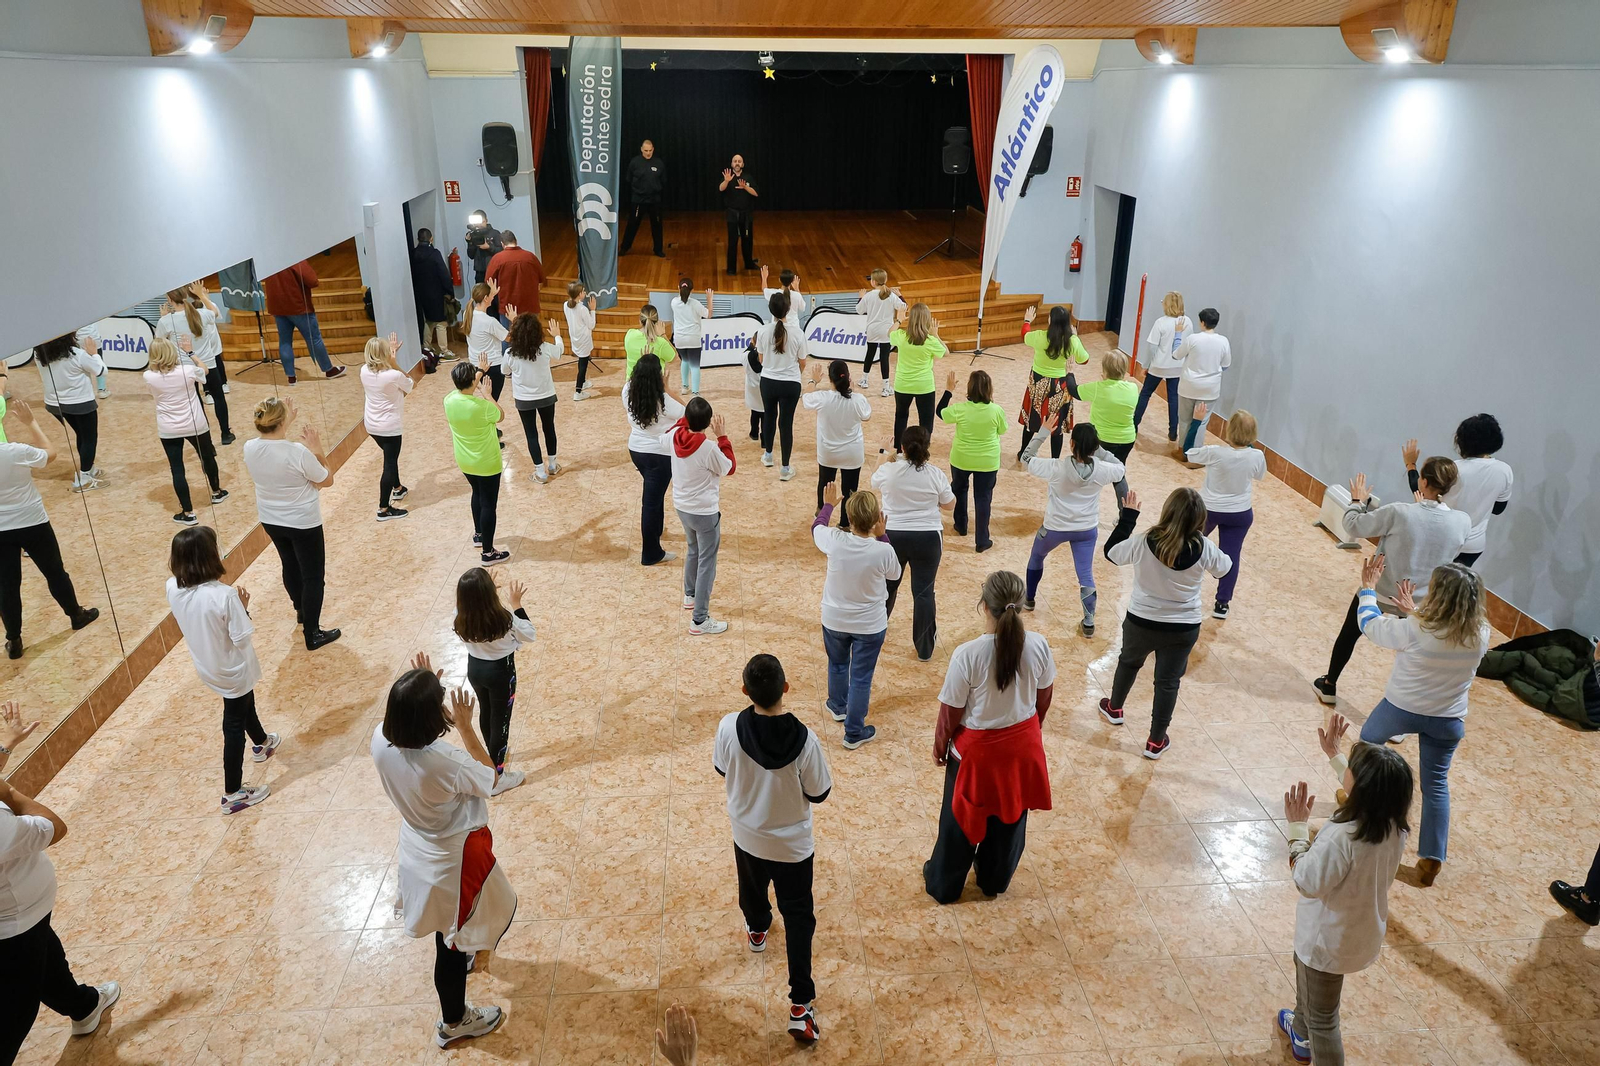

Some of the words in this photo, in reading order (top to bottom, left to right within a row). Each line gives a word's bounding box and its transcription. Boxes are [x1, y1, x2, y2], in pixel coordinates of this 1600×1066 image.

[579, 64, 597, 173] Deputación
[596, 65, 613, 174] Pontevedra
[993, 64, 1054, 203] Atlántico
[701, 332, 752, 351] tlántic
[808, 327, 867, 346] Atlánti
